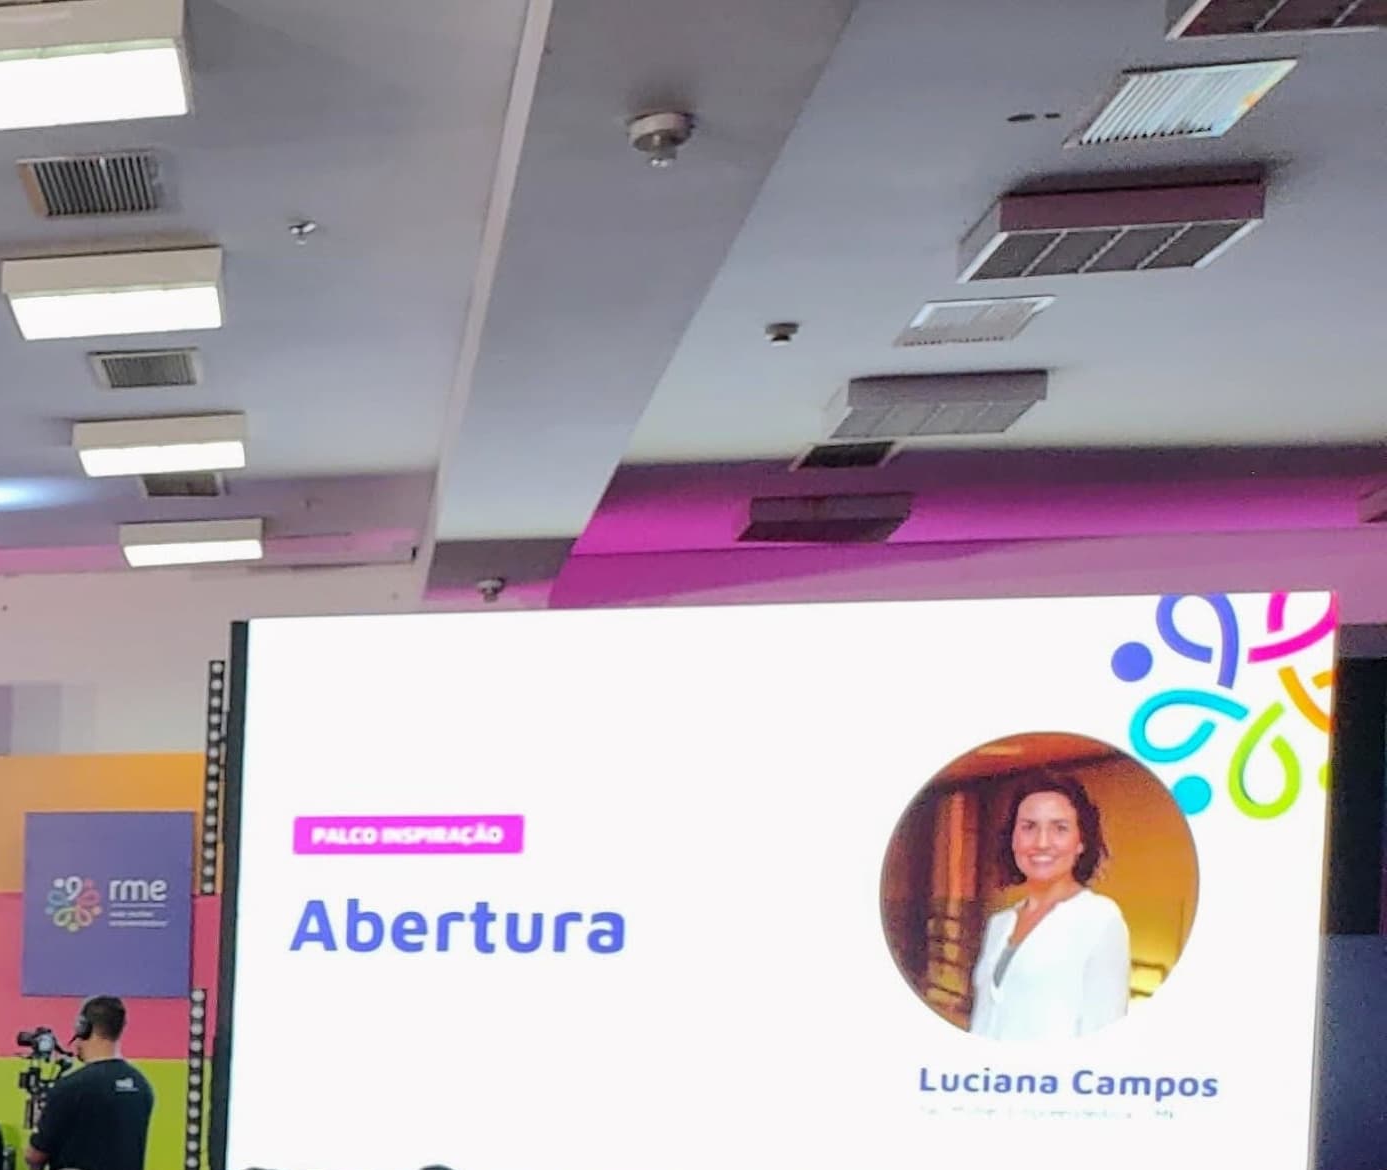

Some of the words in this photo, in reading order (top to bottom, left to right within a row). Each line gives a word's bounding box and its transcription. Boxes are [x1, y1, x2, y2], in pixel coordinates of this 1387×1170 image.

[311, 826, 378, 845] PALCO
[381, 823, 504, 846] INSPIRAÇÃO
[109, 879, 168, 901] rme
[289, 898, 625, 954] Abertura
[919, 1067, 1059, 1094] Luciana
[1072, 1069, 1219, 1103] Campos
